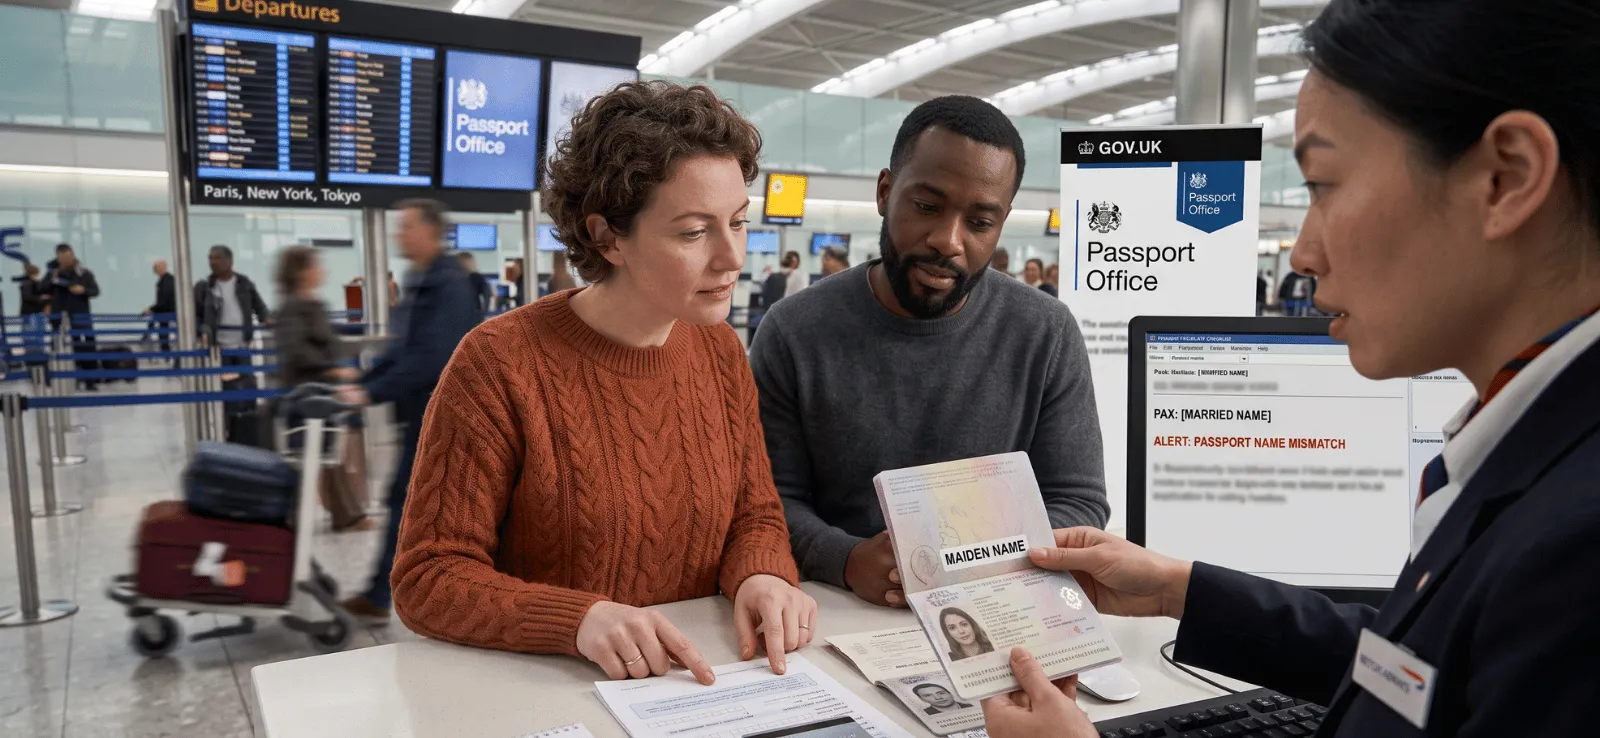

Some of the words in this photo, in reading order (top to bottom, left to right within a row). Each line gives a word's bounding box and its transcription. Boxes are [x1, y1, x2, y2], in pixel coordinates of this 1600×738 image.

[225, 0, 340, 22] Departures
[456, 113, 529, 137] Passport
[455, 134, 506, 155] Office
[1099, 140, 1162, 155] GOV.UK
[204, 185, 243, 200] Paris,
[247, 186, 279, 200] New
[282, 187, 317, 202] York,
[321, 188, 361, 204] Tokyo
[1189, 192, 1236, 204] Passport
[1188, 204, 1220, 215] Office
[1087, 241, 1195, 268] Passport
[1086, 269, 1158, 292] Office
[1154, 408, 1178, 419] PAX:
[1181, 409, 1234, 422] [MARRIED
[1236, 410, 1271, 423] NAME]
[1153, 436, 1191, 447] ALERT:
[1194, 436, 1251, 448] PASSPORT
[1254, 437, 1285, 449] NAME
[1289, 438, 1346, 449] MISMATCH
[945, 546, 990, 566] MAIDEN
[992, 539, 1026, 557] NAME
